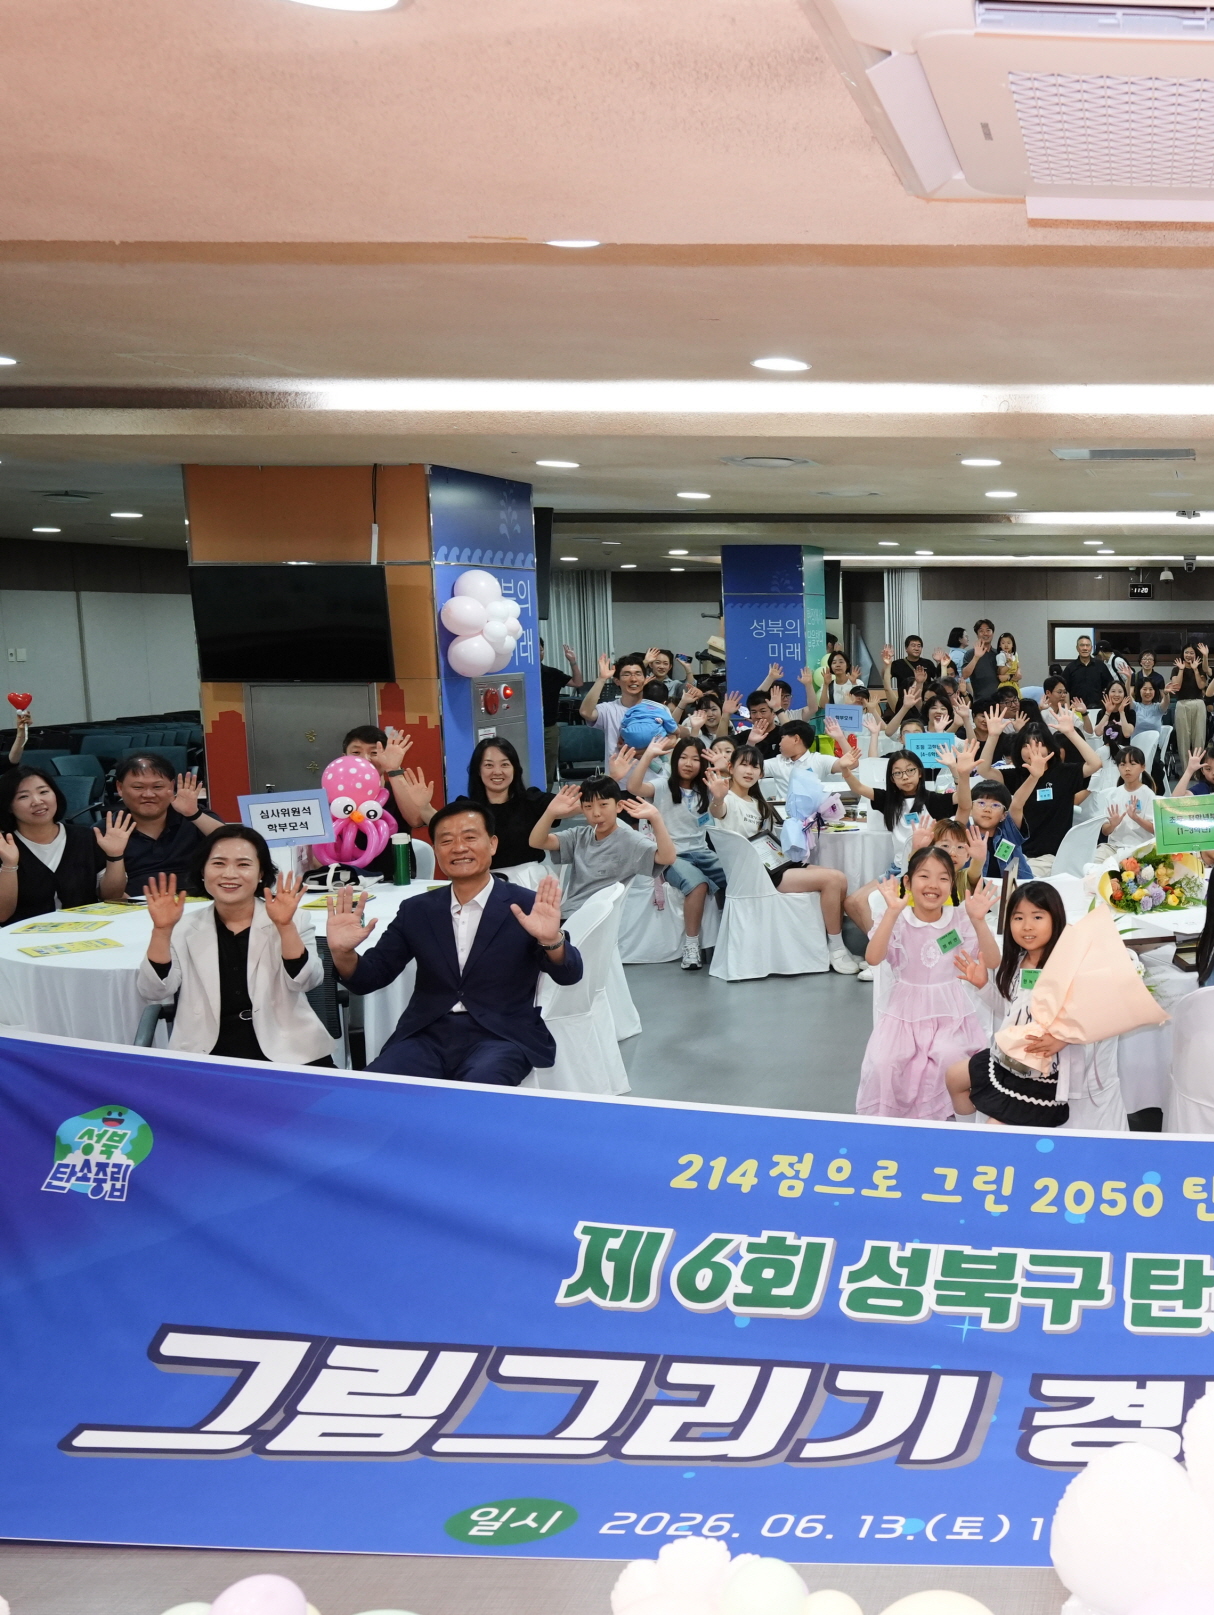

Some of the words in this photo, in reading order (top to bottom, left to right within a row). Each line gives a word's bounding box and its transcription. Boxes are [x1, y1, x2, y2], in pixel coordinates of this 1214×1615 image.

[749, 618, 801, 639] 성북의
[768, 642, 802, 662] 미래
[259, 806, 312, 819] 심사위원석
[267, 821, 309, 832] 학부모석
[41, 1158, 134, 1201] 탄소중립
[921, 1165, 1015, 1213] 그린
[1030, 1177, 1164, 1217] 2050
[557, 1221, 676, 1311] 제
[839, 1239, 1116, 1336] 성북구
[62, 1327, 1000, 1464] 그림그리기
[466, 1505, 565, 1536] 일시
[599, 1511, 741, 1538] 2026.
[760, 1513, 834, 1540] 06.
